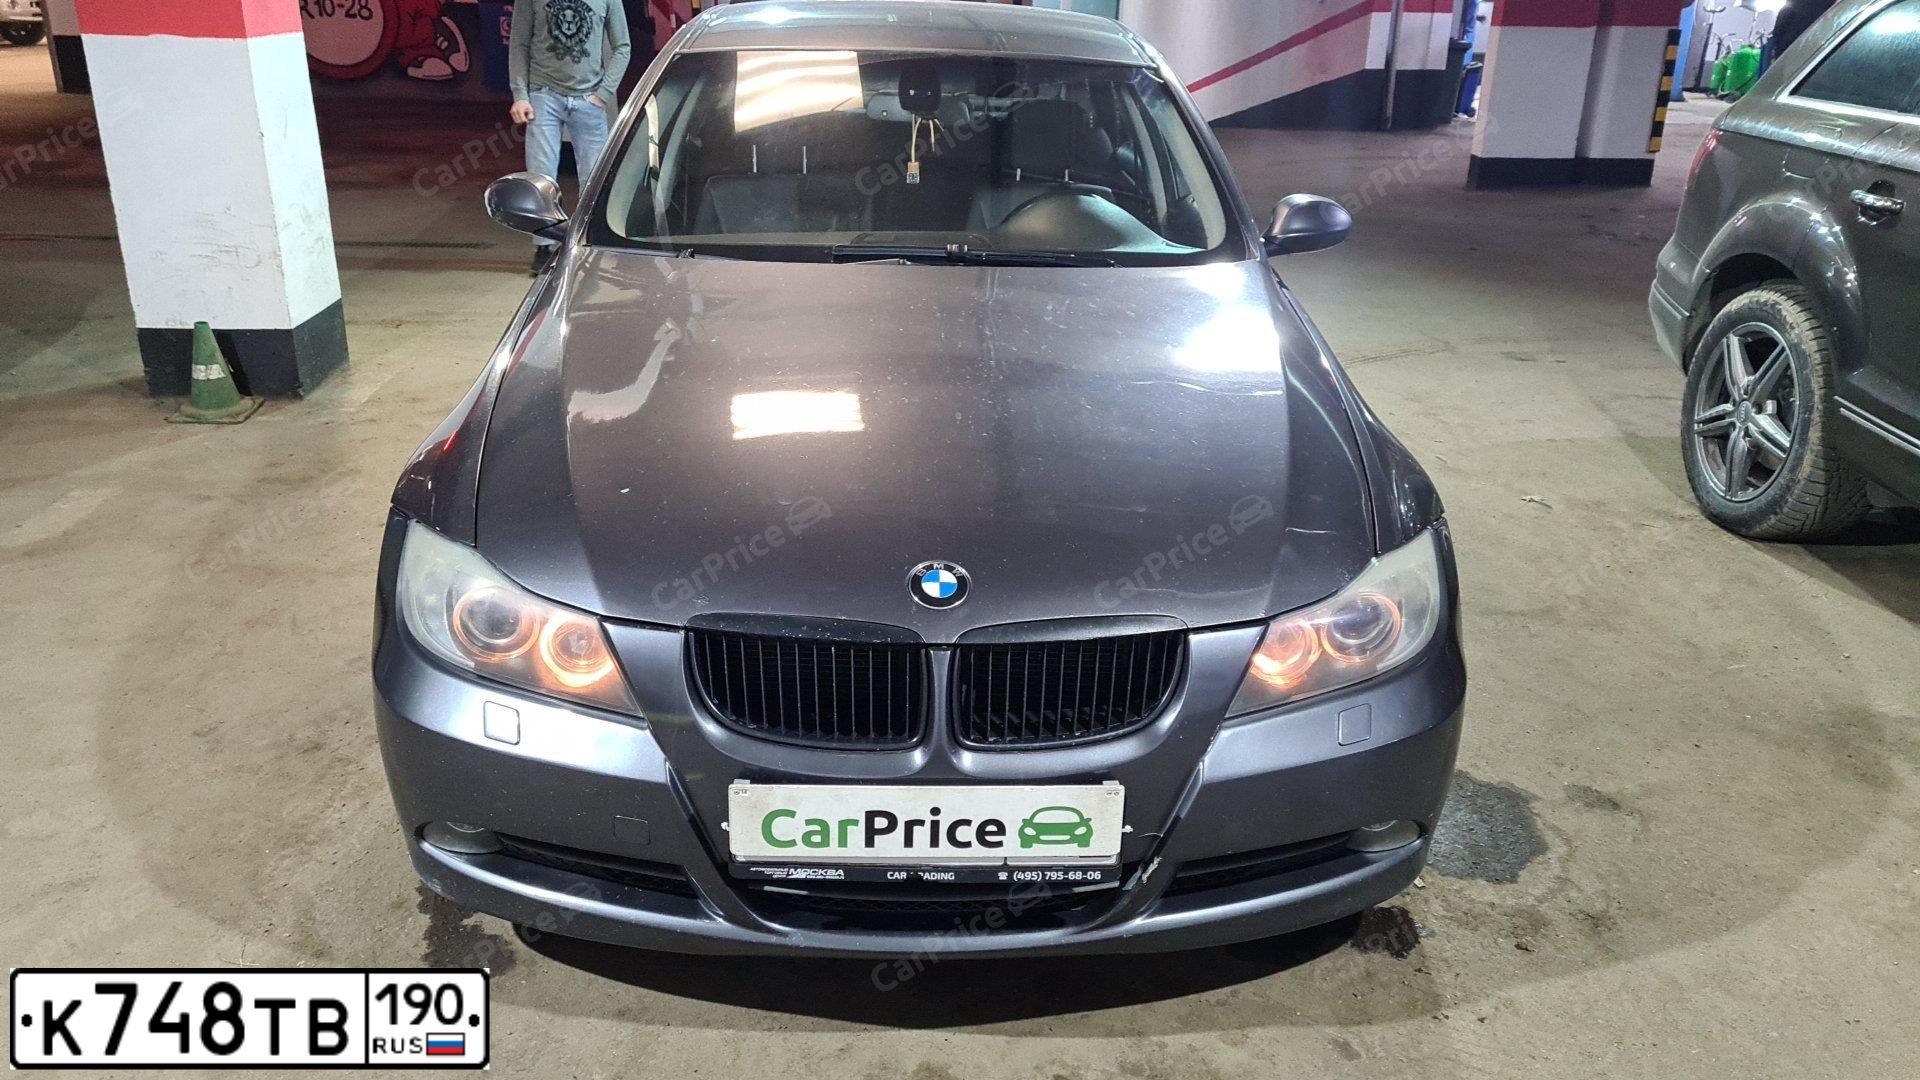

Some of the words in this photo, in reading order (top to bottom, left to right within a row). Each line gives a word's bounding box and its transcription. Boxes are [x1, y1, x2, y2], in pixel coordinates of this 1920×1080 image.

[761, 806, 1007, 850] CarPrice
[887, 871, 907, 880] CAR
[1013, 871, 1042, 881] (495)
[1044, 871, 1102, 881] 795-68-06
